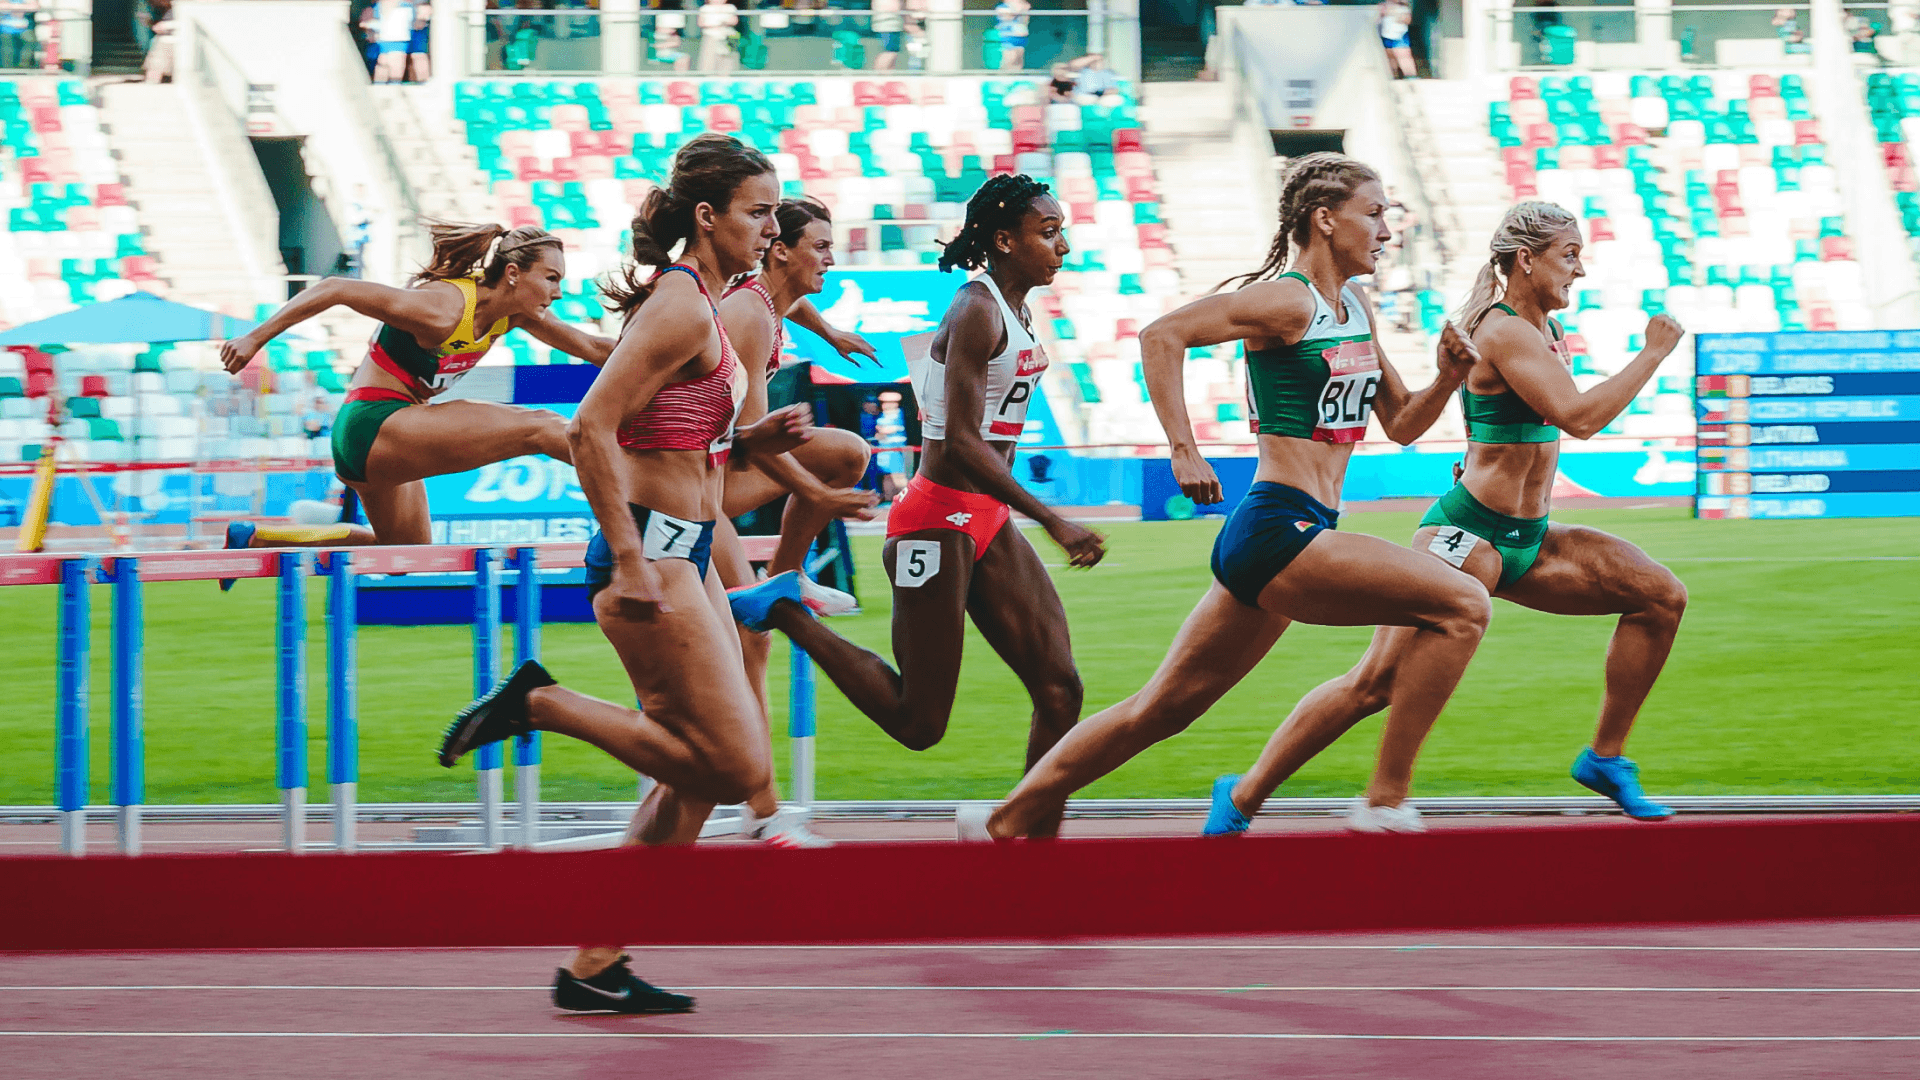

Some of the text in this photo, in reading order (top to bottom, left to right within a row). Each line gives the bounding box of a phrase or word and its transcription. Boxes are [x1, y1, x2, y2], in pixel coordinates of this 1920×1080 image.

[662, 519, 686, 552] 7
[1444, 530, 1465, 552] 4
[907, 548, 927, 578] 5
